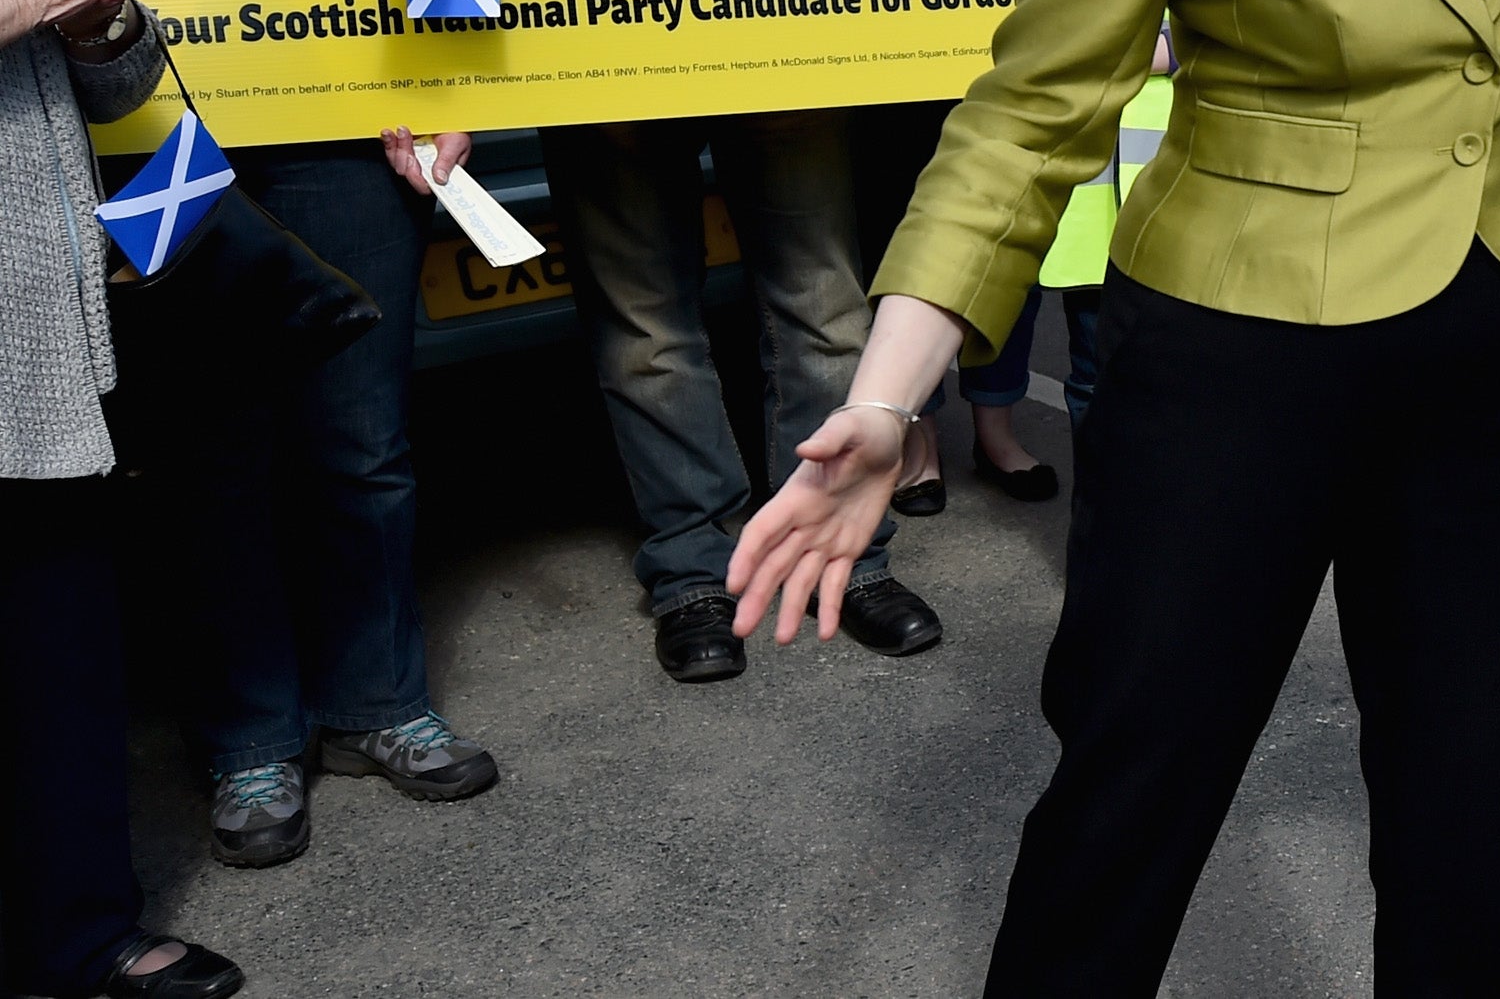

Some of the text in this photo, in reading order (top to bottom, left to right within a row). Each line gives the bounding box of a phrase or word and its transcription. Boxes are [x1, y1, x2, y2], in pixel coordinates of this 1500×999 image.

[150, 9, 230, 46] our
[199, 90, 212, 101] by
[216, 87, 249, 99] Stuart
[253, 86, 279, 96] Pratt
[282, 87, 295, 96] on
[299, 83, 332, 94] behalf
[335, 83, 348, 92] of
[348, 81, 387, 91] Gordon
[420, 78, 443, 88] both
[446, 78, 455, 87] at
[458, 76, 471, 85] 28
[474, 74, 523, 84] Riverview
[558, 70, 582, 80] Ellon
[585, 68, 610, 78] AB41
[643, 65, 676, 75] Printed
[679, 64, 690, 75] by
[730, 60, 769, 70] Hepburn
[772, 59, 778, 67] &
[781, 56, 824, 67] McDonald
[827, 54, 851, 65] Signs
[880, 51, 915, 60] Nicolson
[953, 47, 992, 57] Edinburg
